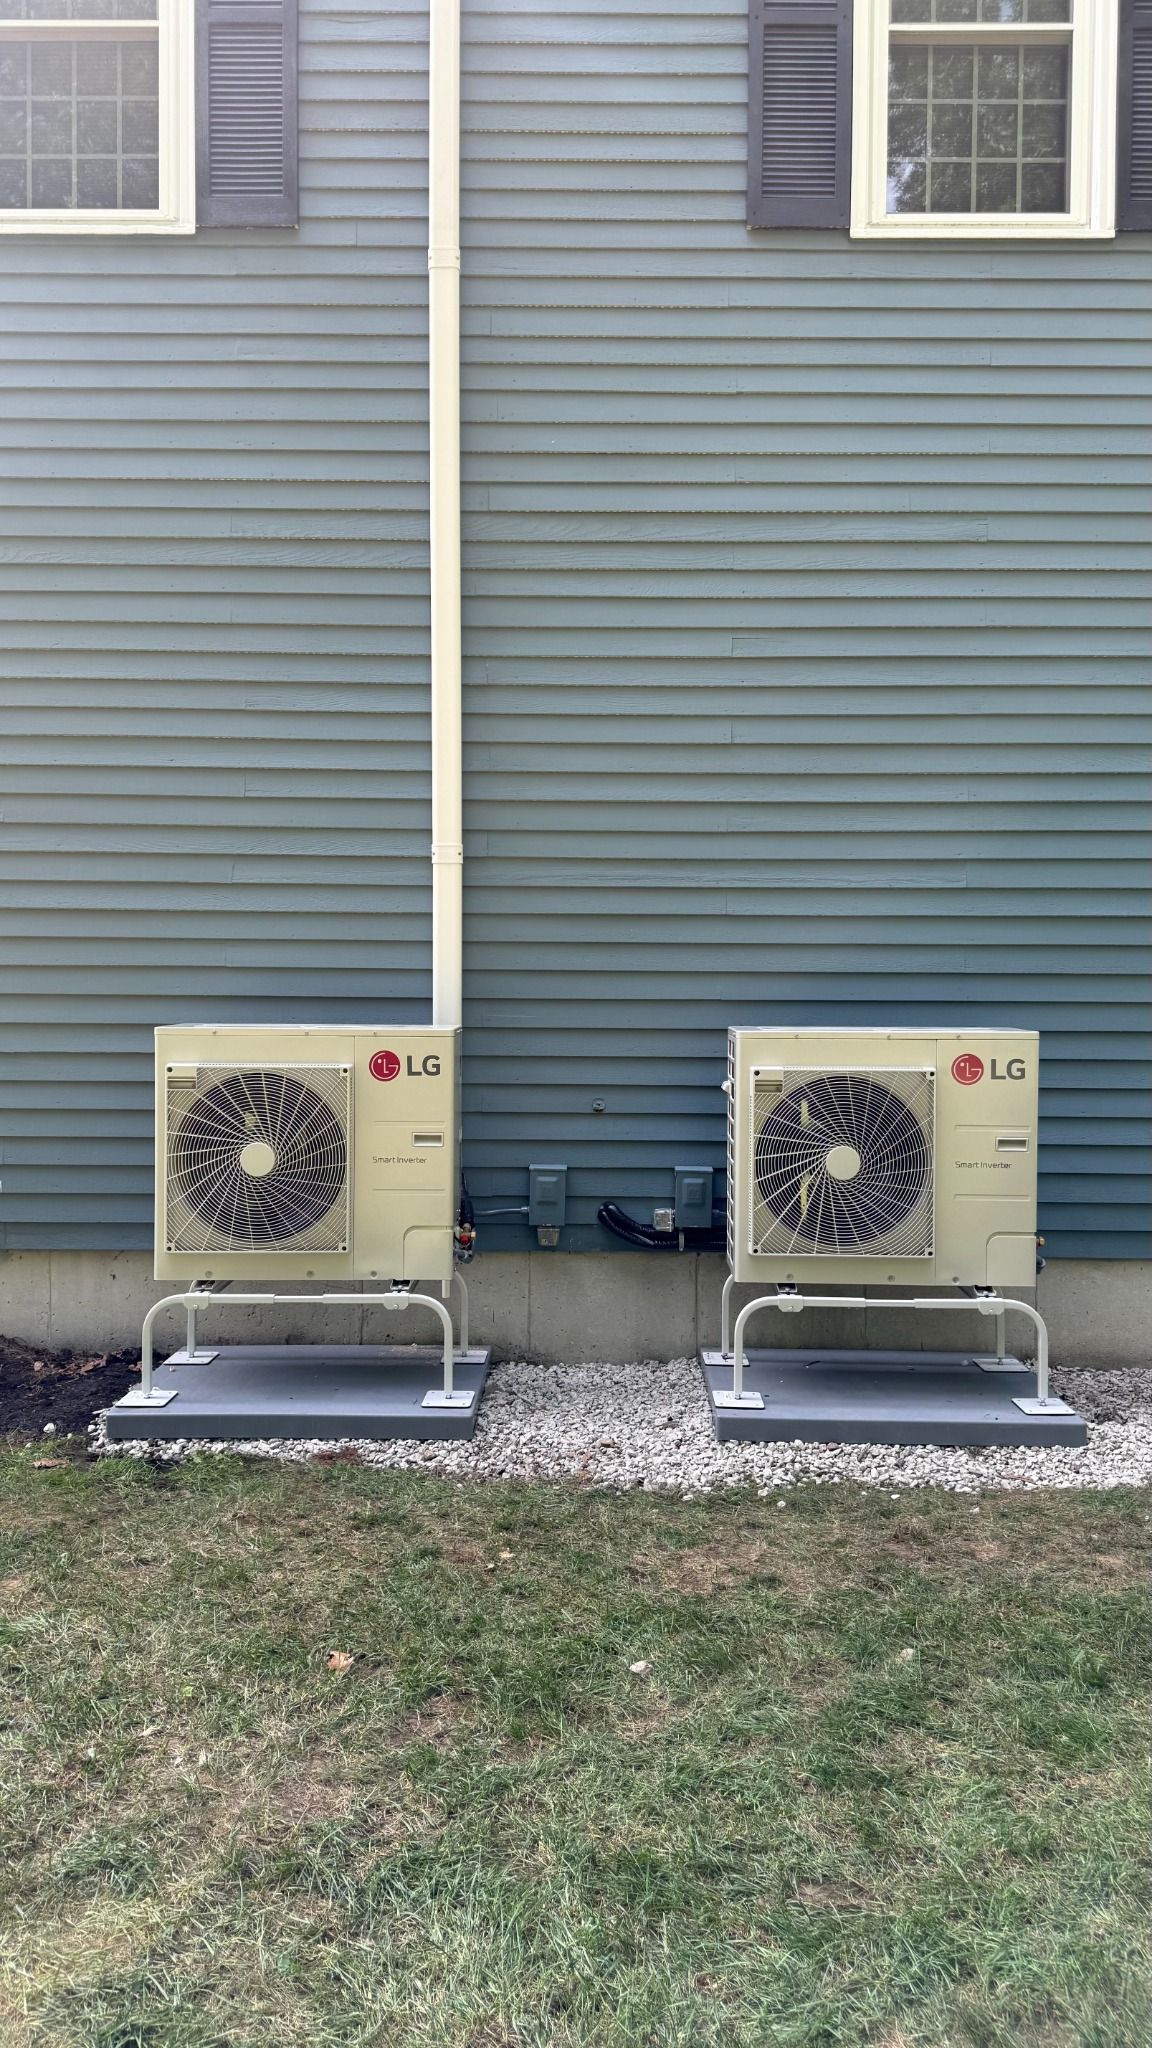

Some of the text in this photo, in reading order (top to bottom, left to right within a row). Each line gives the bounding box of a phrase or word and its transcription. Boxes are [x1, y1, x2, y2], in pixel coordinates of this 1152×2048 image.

[406, 1055, 441, 1076] LG
[990, 1058, 1026, 1080] LG
[372, 1156, 427, 1164] Smart Inverter
[955, 1161, 1012, 1169] Smart Inverter
